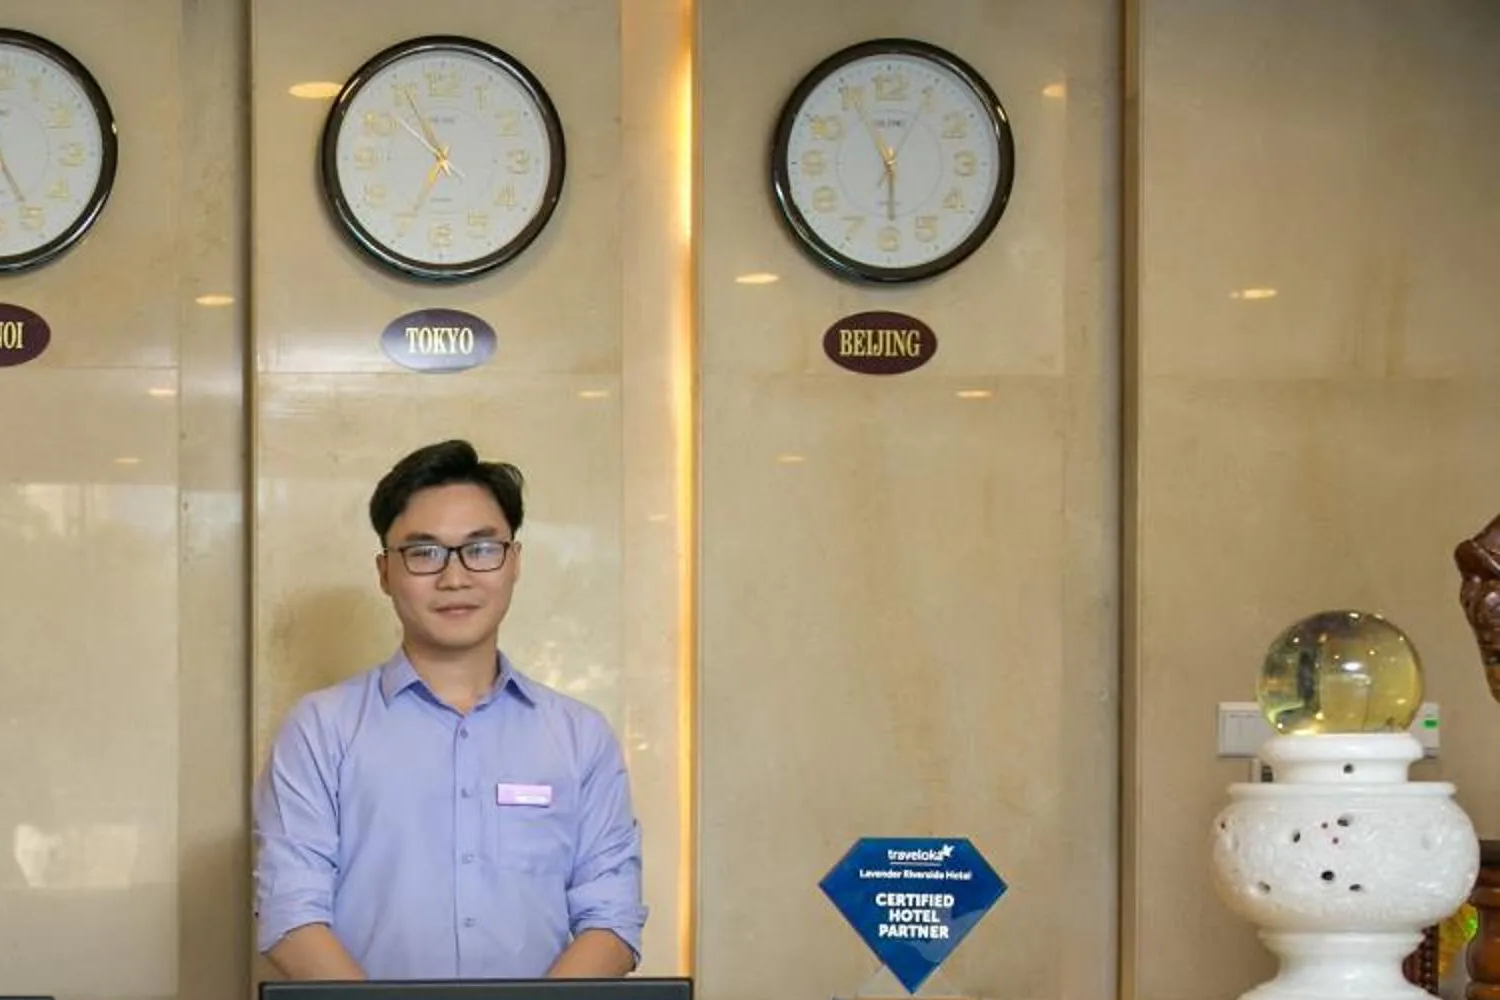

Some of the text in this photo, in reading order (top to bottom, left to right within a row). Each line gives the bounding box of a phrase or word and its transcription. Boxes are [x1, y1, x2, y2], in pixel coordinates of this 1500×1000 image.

[405, 326, 474, 355] TOKYO
[840, 329, 920, 357] BEIJING
[888, 849, 944, 861] traveloka
[860, 869, 902, 879] Lavender
[875, 893, 955, 908] CERTIFIED
[889, 909, 940, 923] HOTEL
[879, 924, 949, 939] PARTNER
